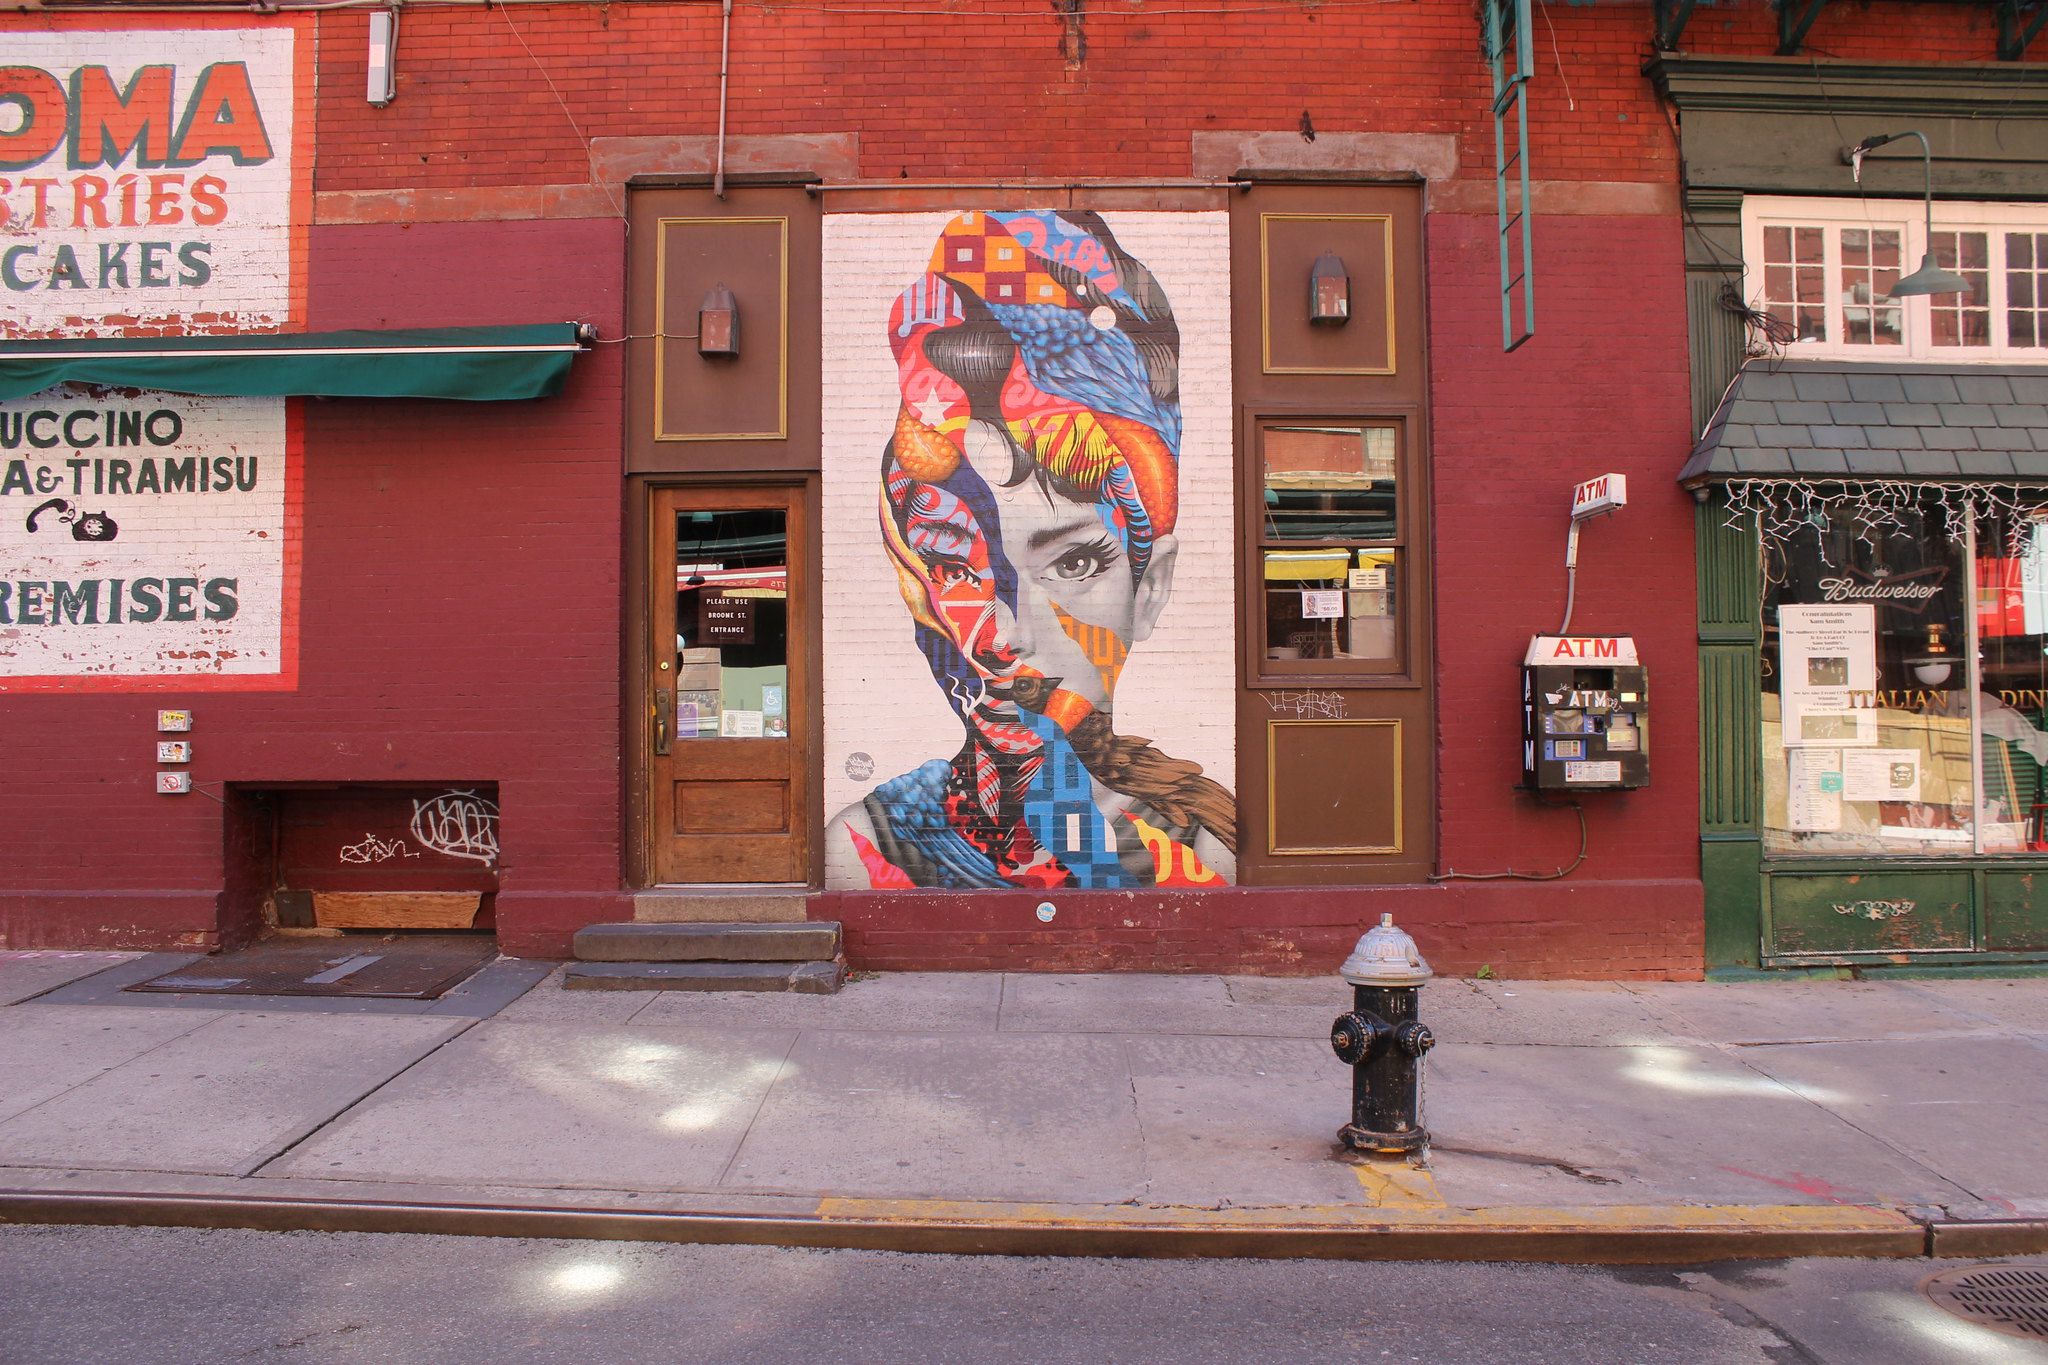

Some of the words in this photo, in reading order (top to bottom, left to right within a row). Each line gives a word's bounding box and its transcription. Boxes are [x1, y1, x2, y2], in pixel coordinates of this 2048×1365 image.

[1, 241, 213, 292] CAKES
[0, 409, 183, 449] UCCINO
[1576, 477, 1608, 506] ATM
[1818, 578, 1944, 601] Budweiser
[1553, 638, 1618, 658] ATM
[1568, 690, 1608, 708] ATM
[1848, 689, 1949, 709] ITALIAN
